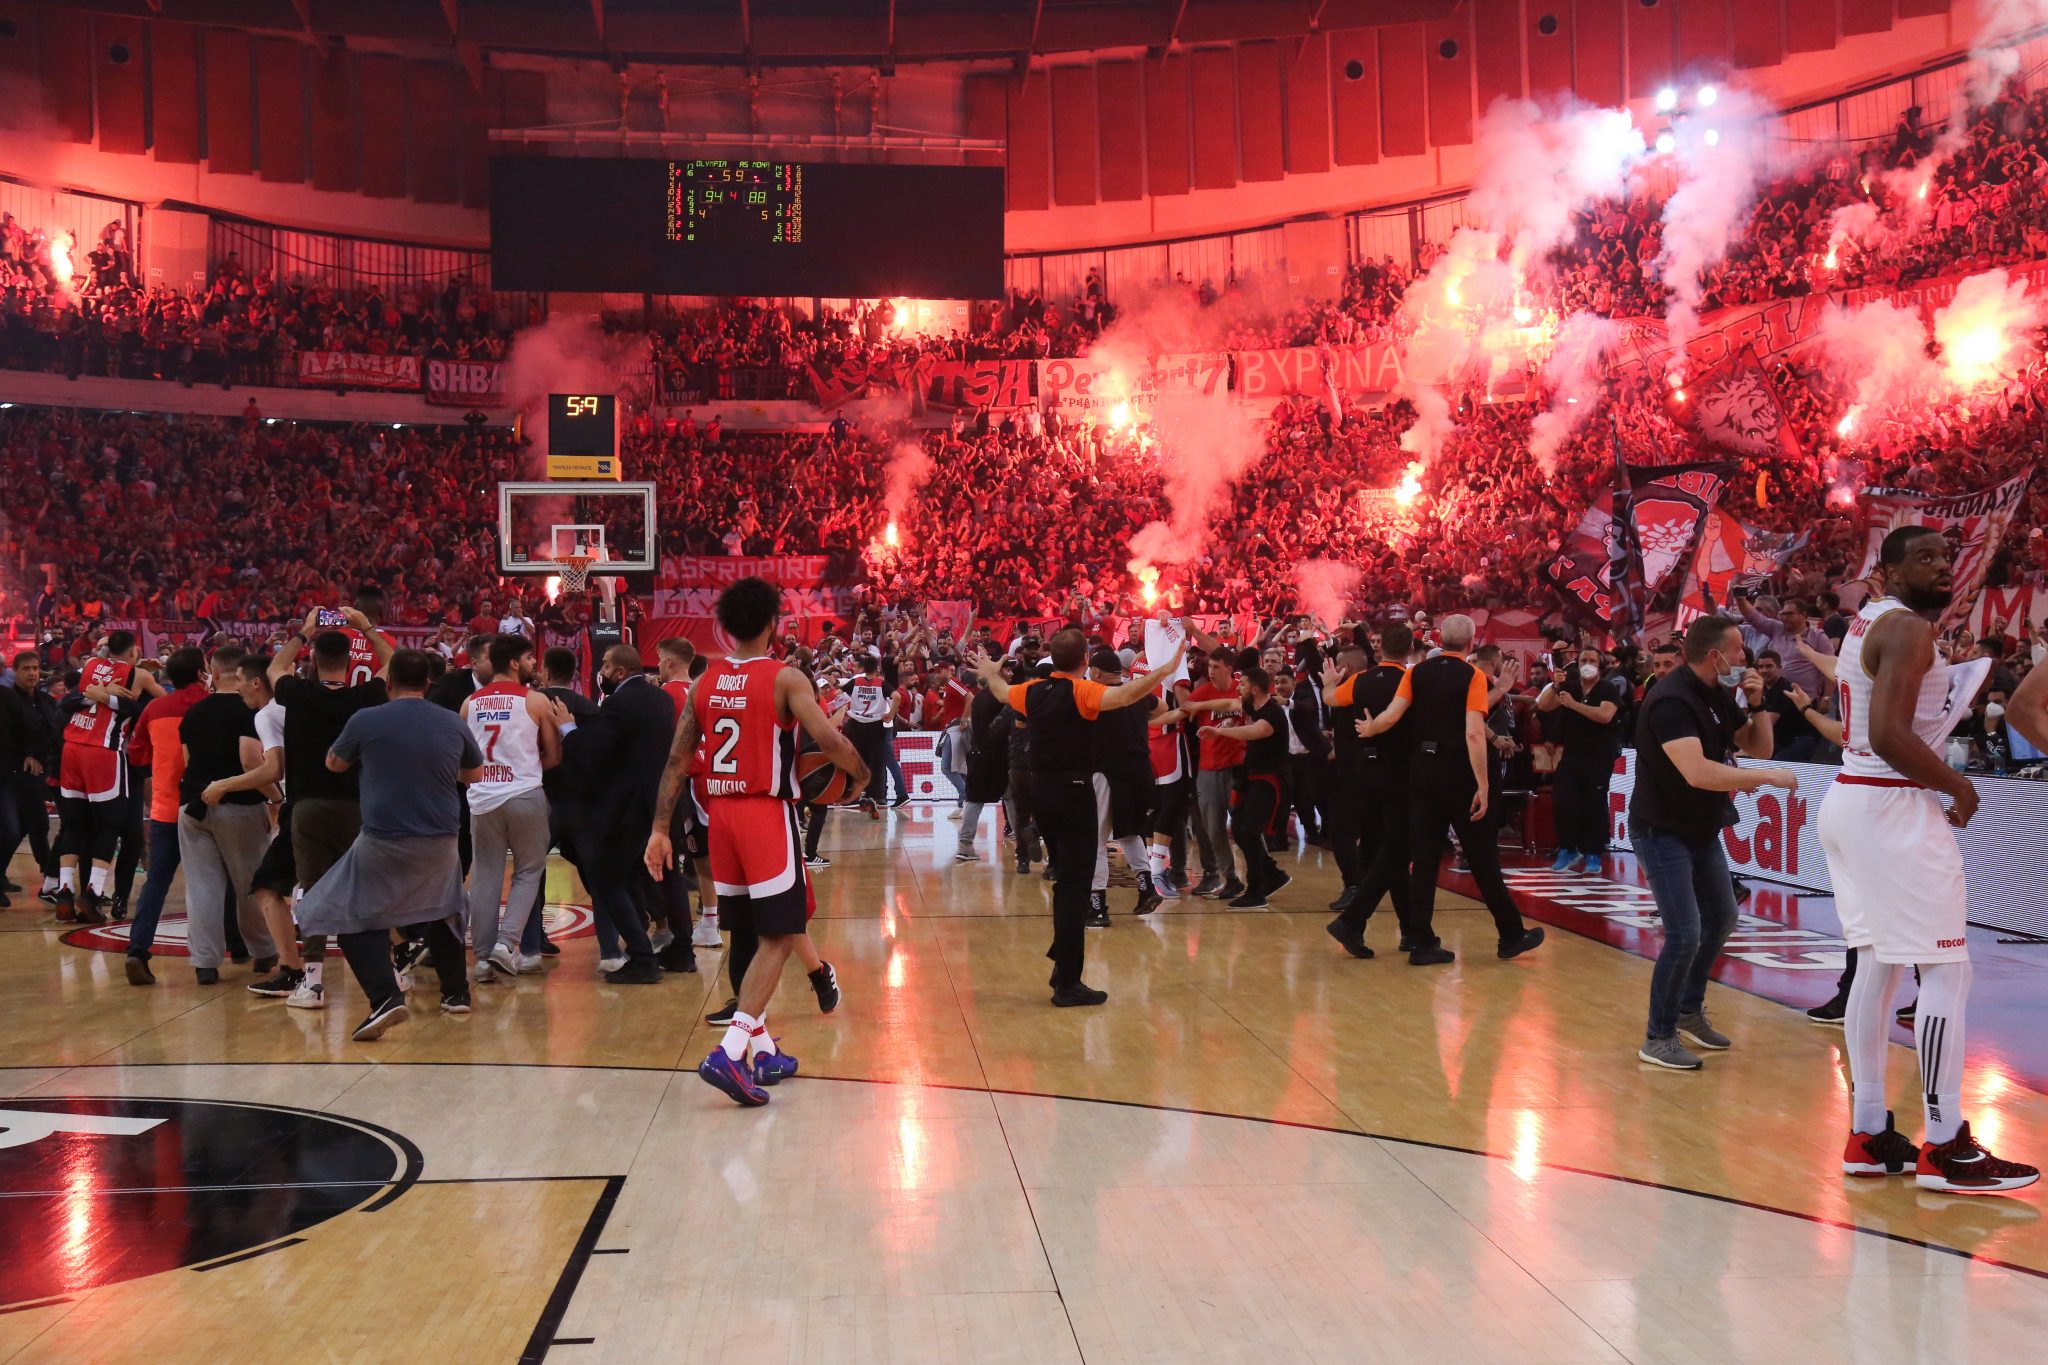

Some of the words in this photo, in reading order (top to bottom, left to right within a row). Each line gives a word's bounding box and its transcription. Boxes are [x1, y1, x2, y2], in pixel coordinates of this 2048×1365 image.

[706, 190, 723, 202] 94
[730, 192, 737, 200] 4
[749, 192, 766, 203] 88
[352, 638, 366, 650] FALL
[716, 674, 748, 691] DORSEY
[476, 697, 514, 711] SPANOULIS
[709, 695, 746, 709] FMS
[477, 712, 510, 722] FMS
[484, 724, 501, 762] 7
[713, 717, 740, 773] 2
